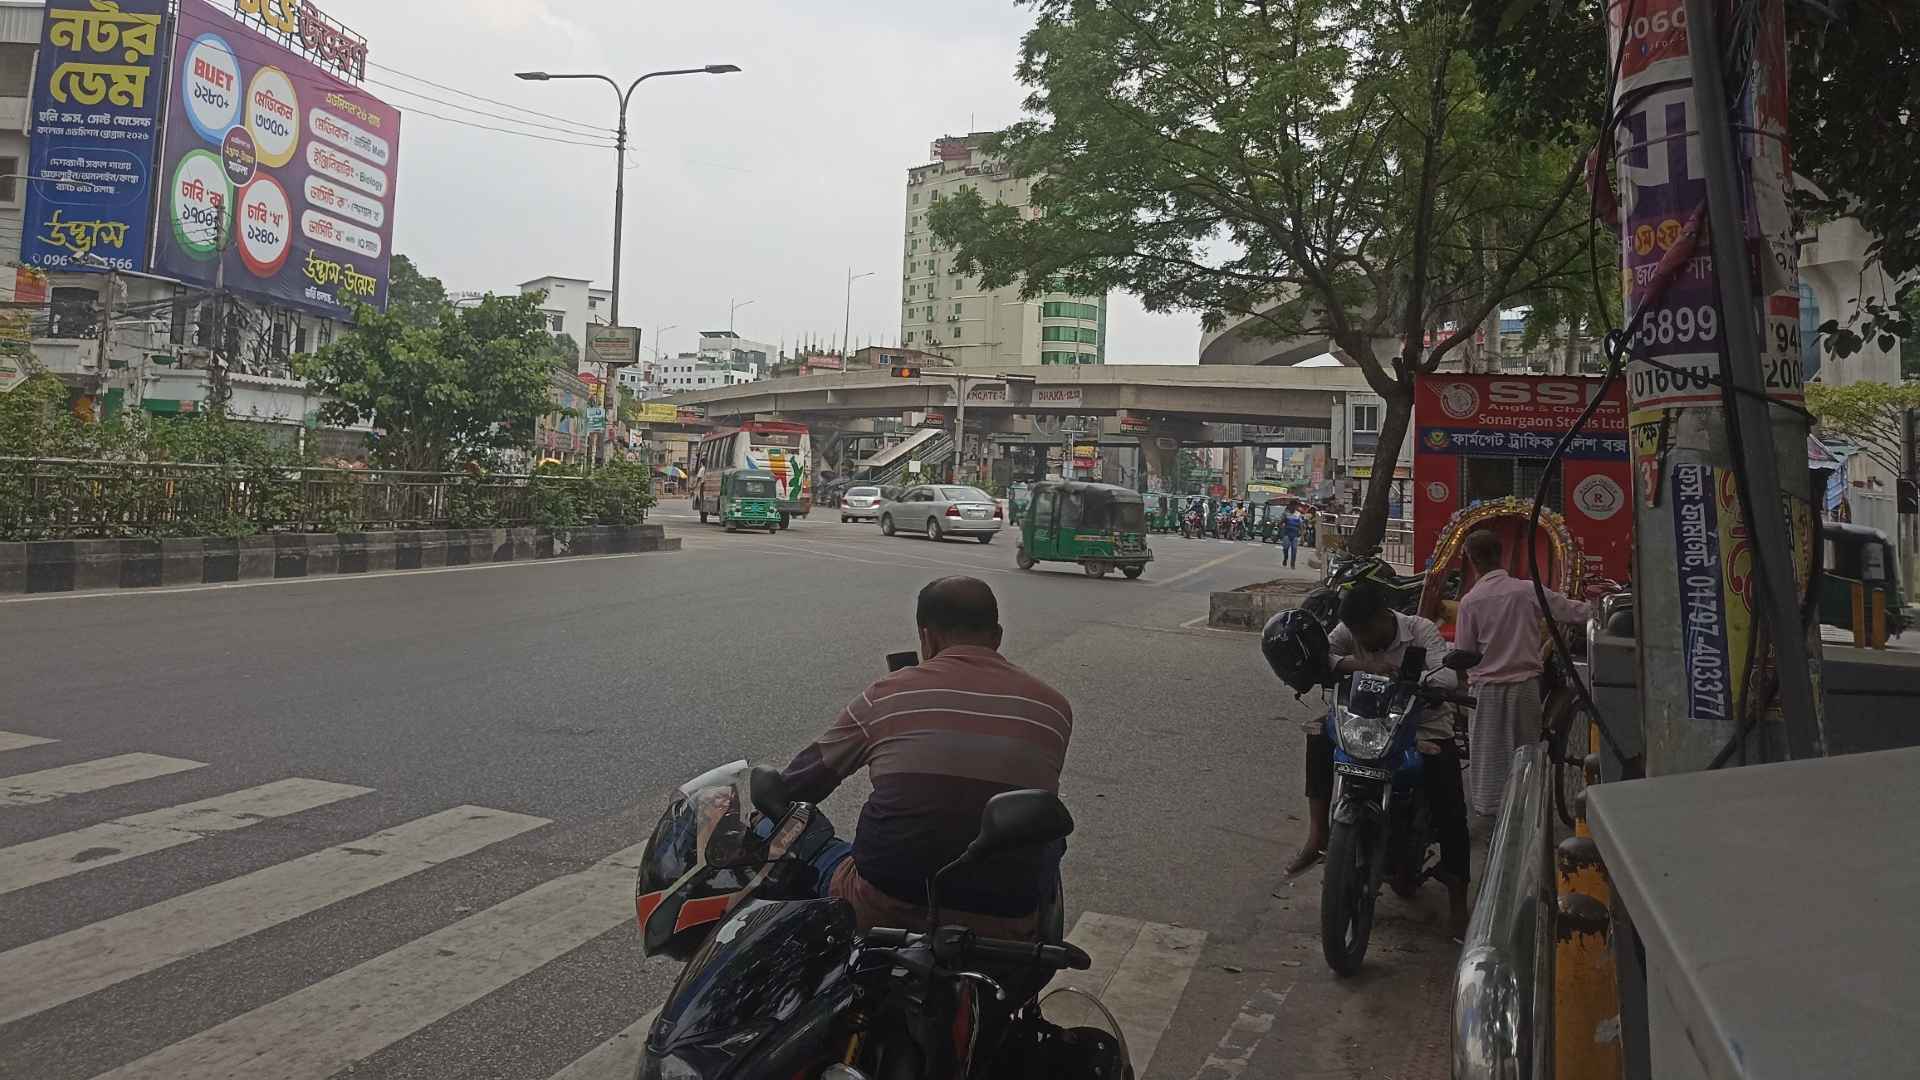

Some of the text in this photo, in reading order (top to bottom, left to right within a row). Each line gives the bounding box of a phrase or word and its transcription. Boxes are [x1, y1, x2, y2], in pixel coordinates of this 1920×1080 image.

[49, 0, 162, 63] নটর
[49, 62, 151, 108] ডেম
[193, 57, 235, 91] BUET
[194, 82, 229, 109] ১২৮০+
[254, 89, 294, 121] মেডিকেল
[182, 178, 205, 203] ঢাবি
[247, 202, 268, 224] ঢাবি
[37, 209, 130, 253] উদ্ভাস
[247, 224, 280, 246] ১২৪০+
[1488, 381, 1621, 407] SSL
[1479, 413, 1554, 430] Sonargaon
[1556, 416, 1599, 430] Stels
[1487, 403, 1535, 414] Angle
[1452, 430, 1506, 449] ফার্মগেট
[1508, 431, 1555, 451] ট্রাফিক
[1601, 439, 1628, 454] বক্স
[1685, 576, 1727, 718] 01797-403377
